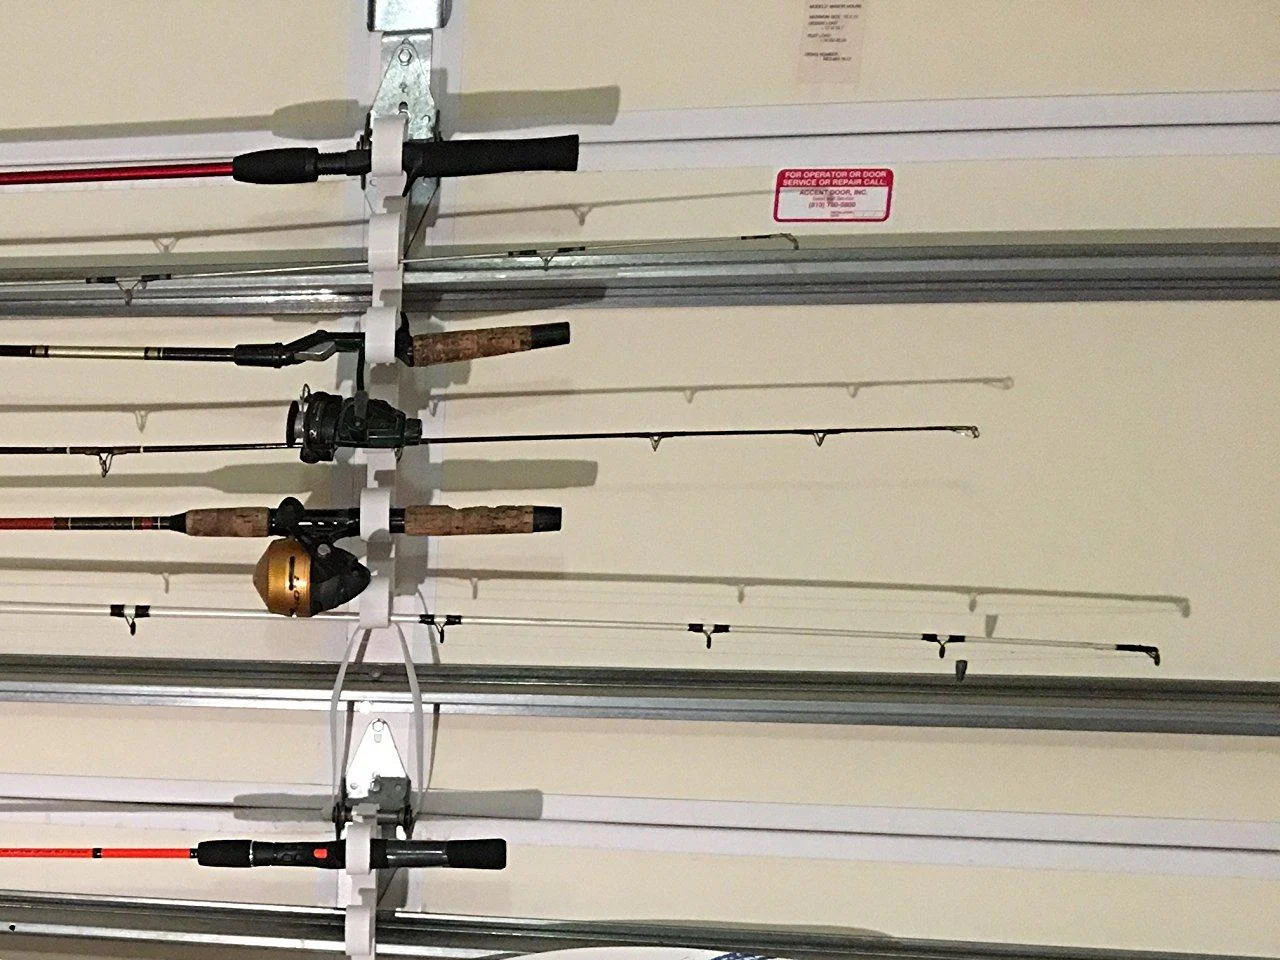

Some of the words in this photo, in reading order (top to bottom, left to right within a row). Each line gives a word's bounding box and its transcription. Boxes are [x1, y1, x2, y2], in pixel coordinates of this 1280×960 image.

[783, 178, 817, 186] SERVICE
[818, 178, 831, 186] OR
[832, 178, 862, 186] REPAIR
